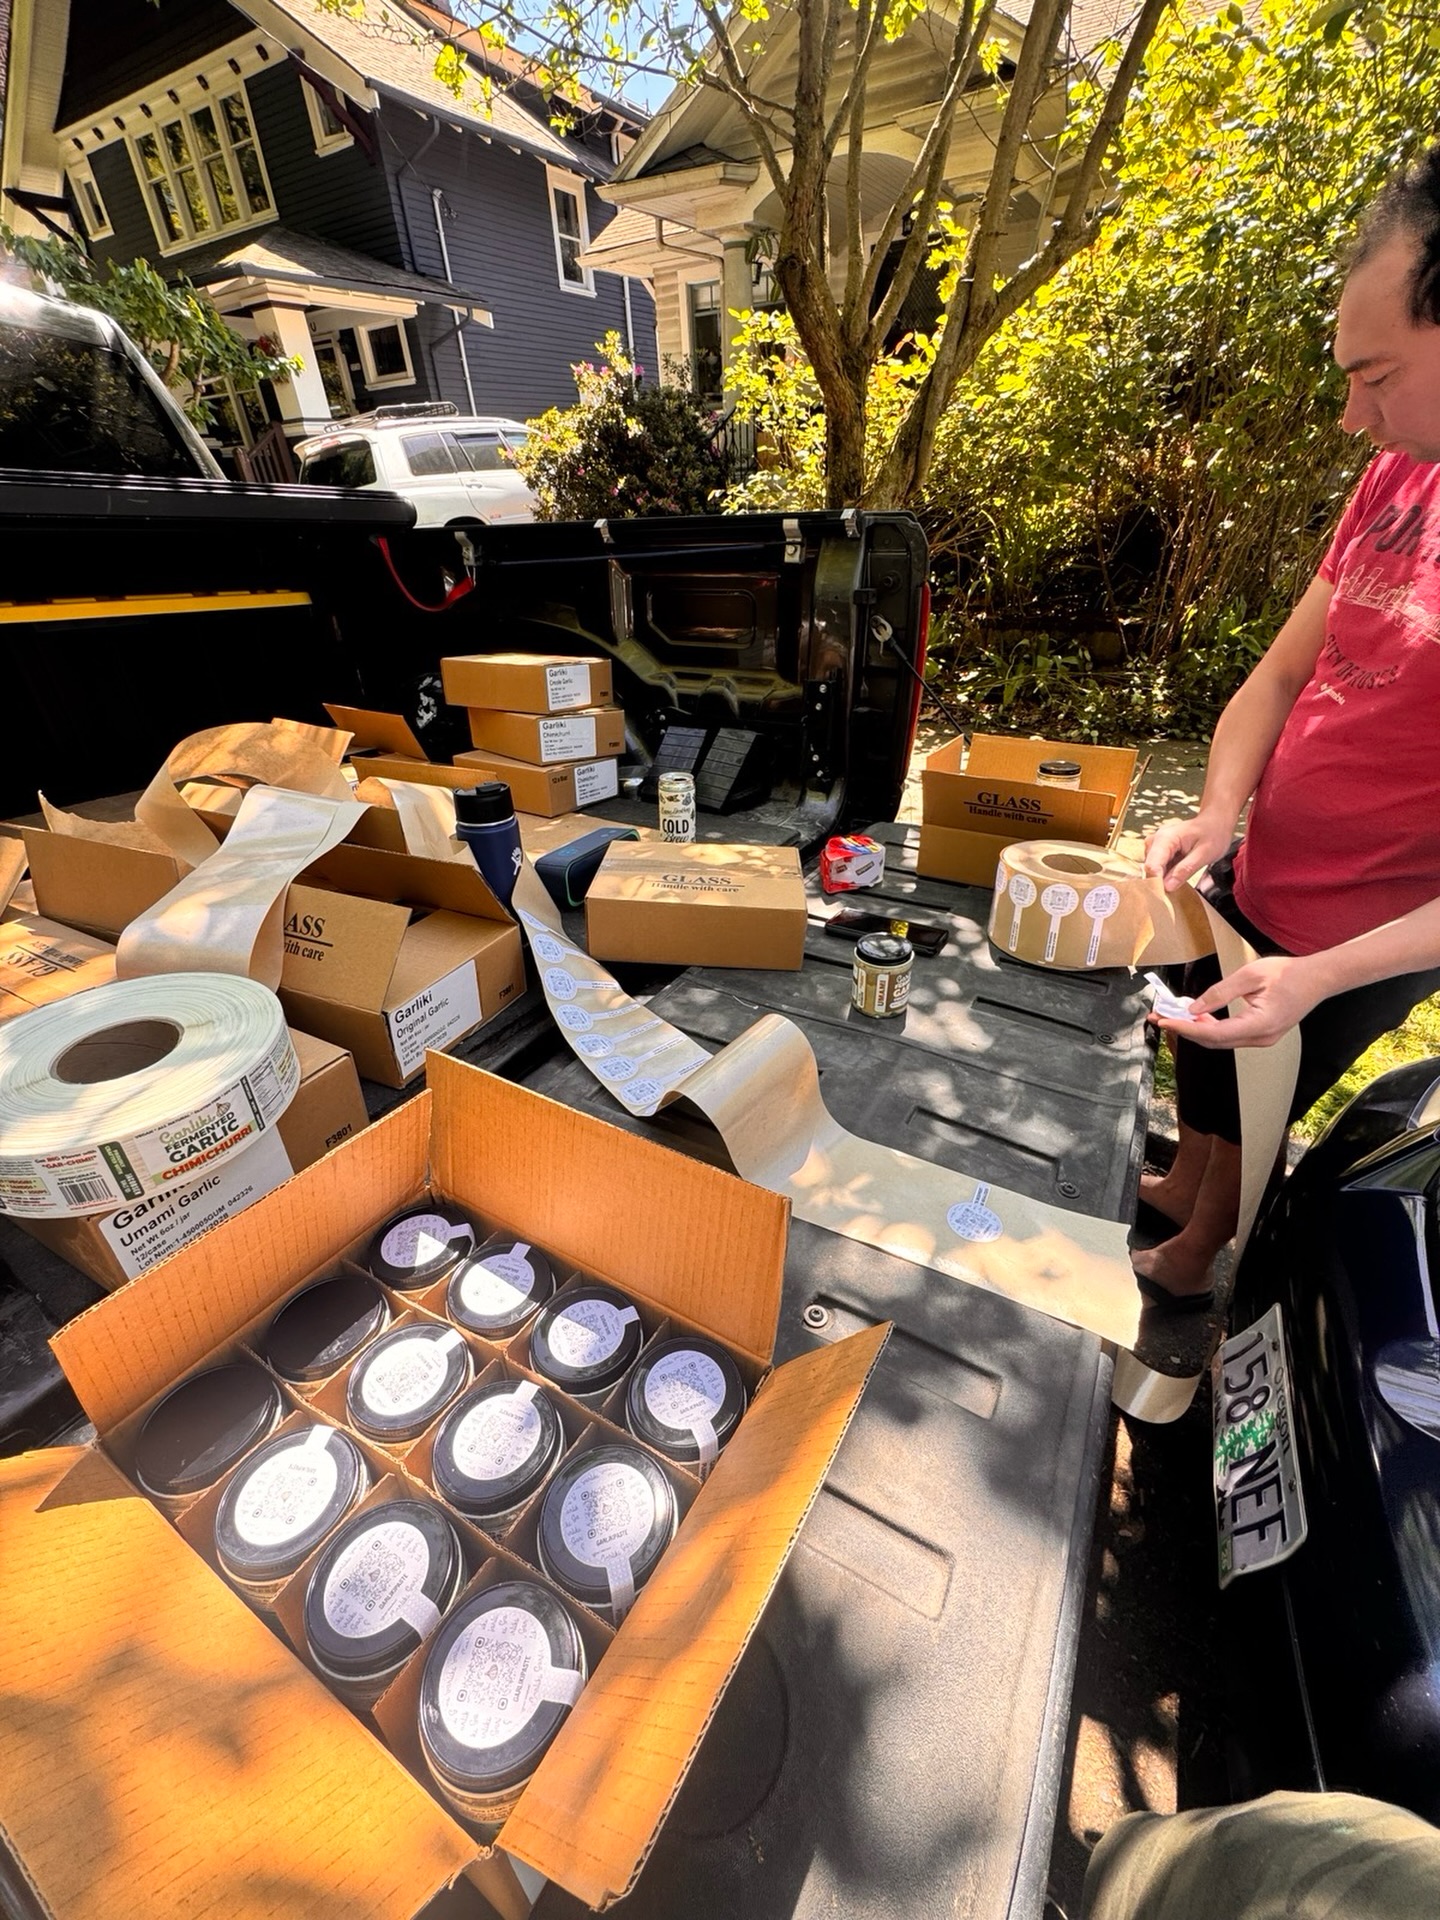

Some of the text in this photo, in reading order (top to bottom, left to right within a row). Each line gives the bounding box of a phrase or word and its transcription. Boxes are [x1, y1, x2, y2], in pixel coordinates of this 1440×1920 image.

[549, 667, 568, 677] Garliki
[543, 720, 567, 730] Garliki
[577, 765, 596, 776] Garliki
[977, 791, 1041, 812] GLASS
[662, 818, 689, 834] COLD
[969, 805, 1047, 825] Handle with care
[651, 882, 689, 890] Handle
[662, 873, 732, 885] GLASS
[284, 912, 326, 938] ASS
[302, 947, 324, 961] care
[877, 980, 886, 1007] UMAMI
[395, 990, 433, 1024] Garliki
[396, 1012, 427, 1039] Original
[428, 998, 449, 1017] Garlic
[160, 1114, 217, 1146] Garliki
[164, 1111, 235, 1154] FERMENTED
[169, 1119, 239, 1163] GARLIC
[325, 1123, 352, 1148] F3801
[162, 1124, 253, 1180] CHIMICHURRI
[120, 1204, 176, 1248] Umami
[178, 1175, 221, 1208] Garlic
[130, 1244, 146, 1256] Net
[146, 1234, 159, 1248] Wt
[159, 1225, 174, 1236] 6oz
[179, 1212, 191, 1225] jar
[135, 1239, 167, 1263] 12/case
[138, 1258, 154, 1271] Lot
[1273, 1366, 1292, 1455] Oregon
[1222, 1331, 1288, 1545] 158 NEF
[513, 1655, 531, 1703] GARLIKIPASTE
